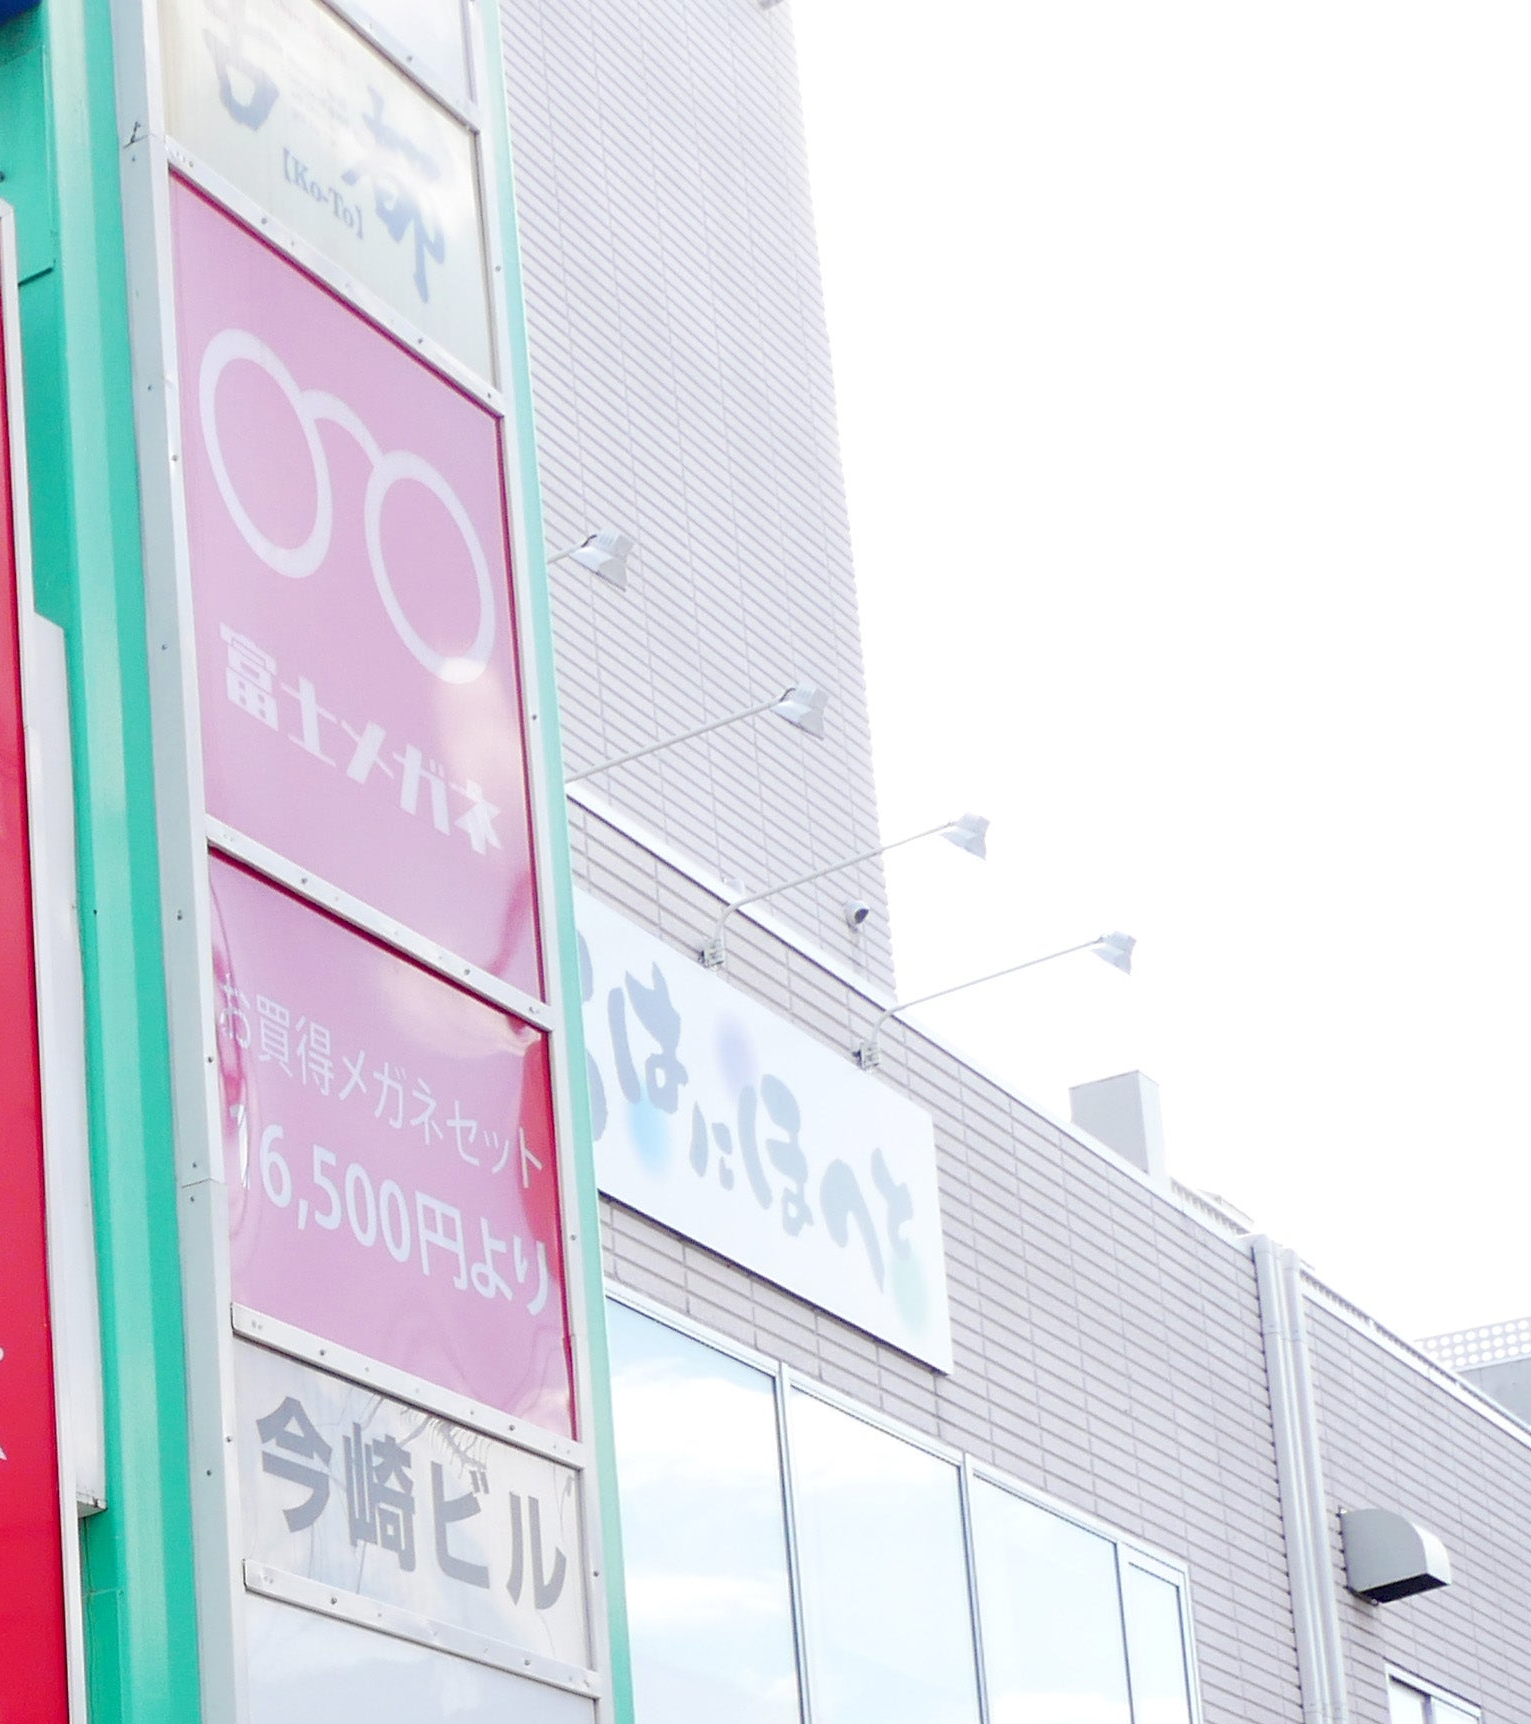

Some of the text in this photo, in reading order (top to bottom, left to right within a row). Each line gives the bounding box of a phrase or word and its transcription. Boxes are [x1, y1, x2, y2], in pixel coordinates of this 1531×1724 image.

[219, 622, 503, 856] 富士メガネ
[215, 972, 543, 1188] お買得メガネセット
[576, 930, 915, 1295] はにほへと
[229, 1104, 551, 1316] 16,500円より
[254, 1396, 568, 1612] 今崎ビル
